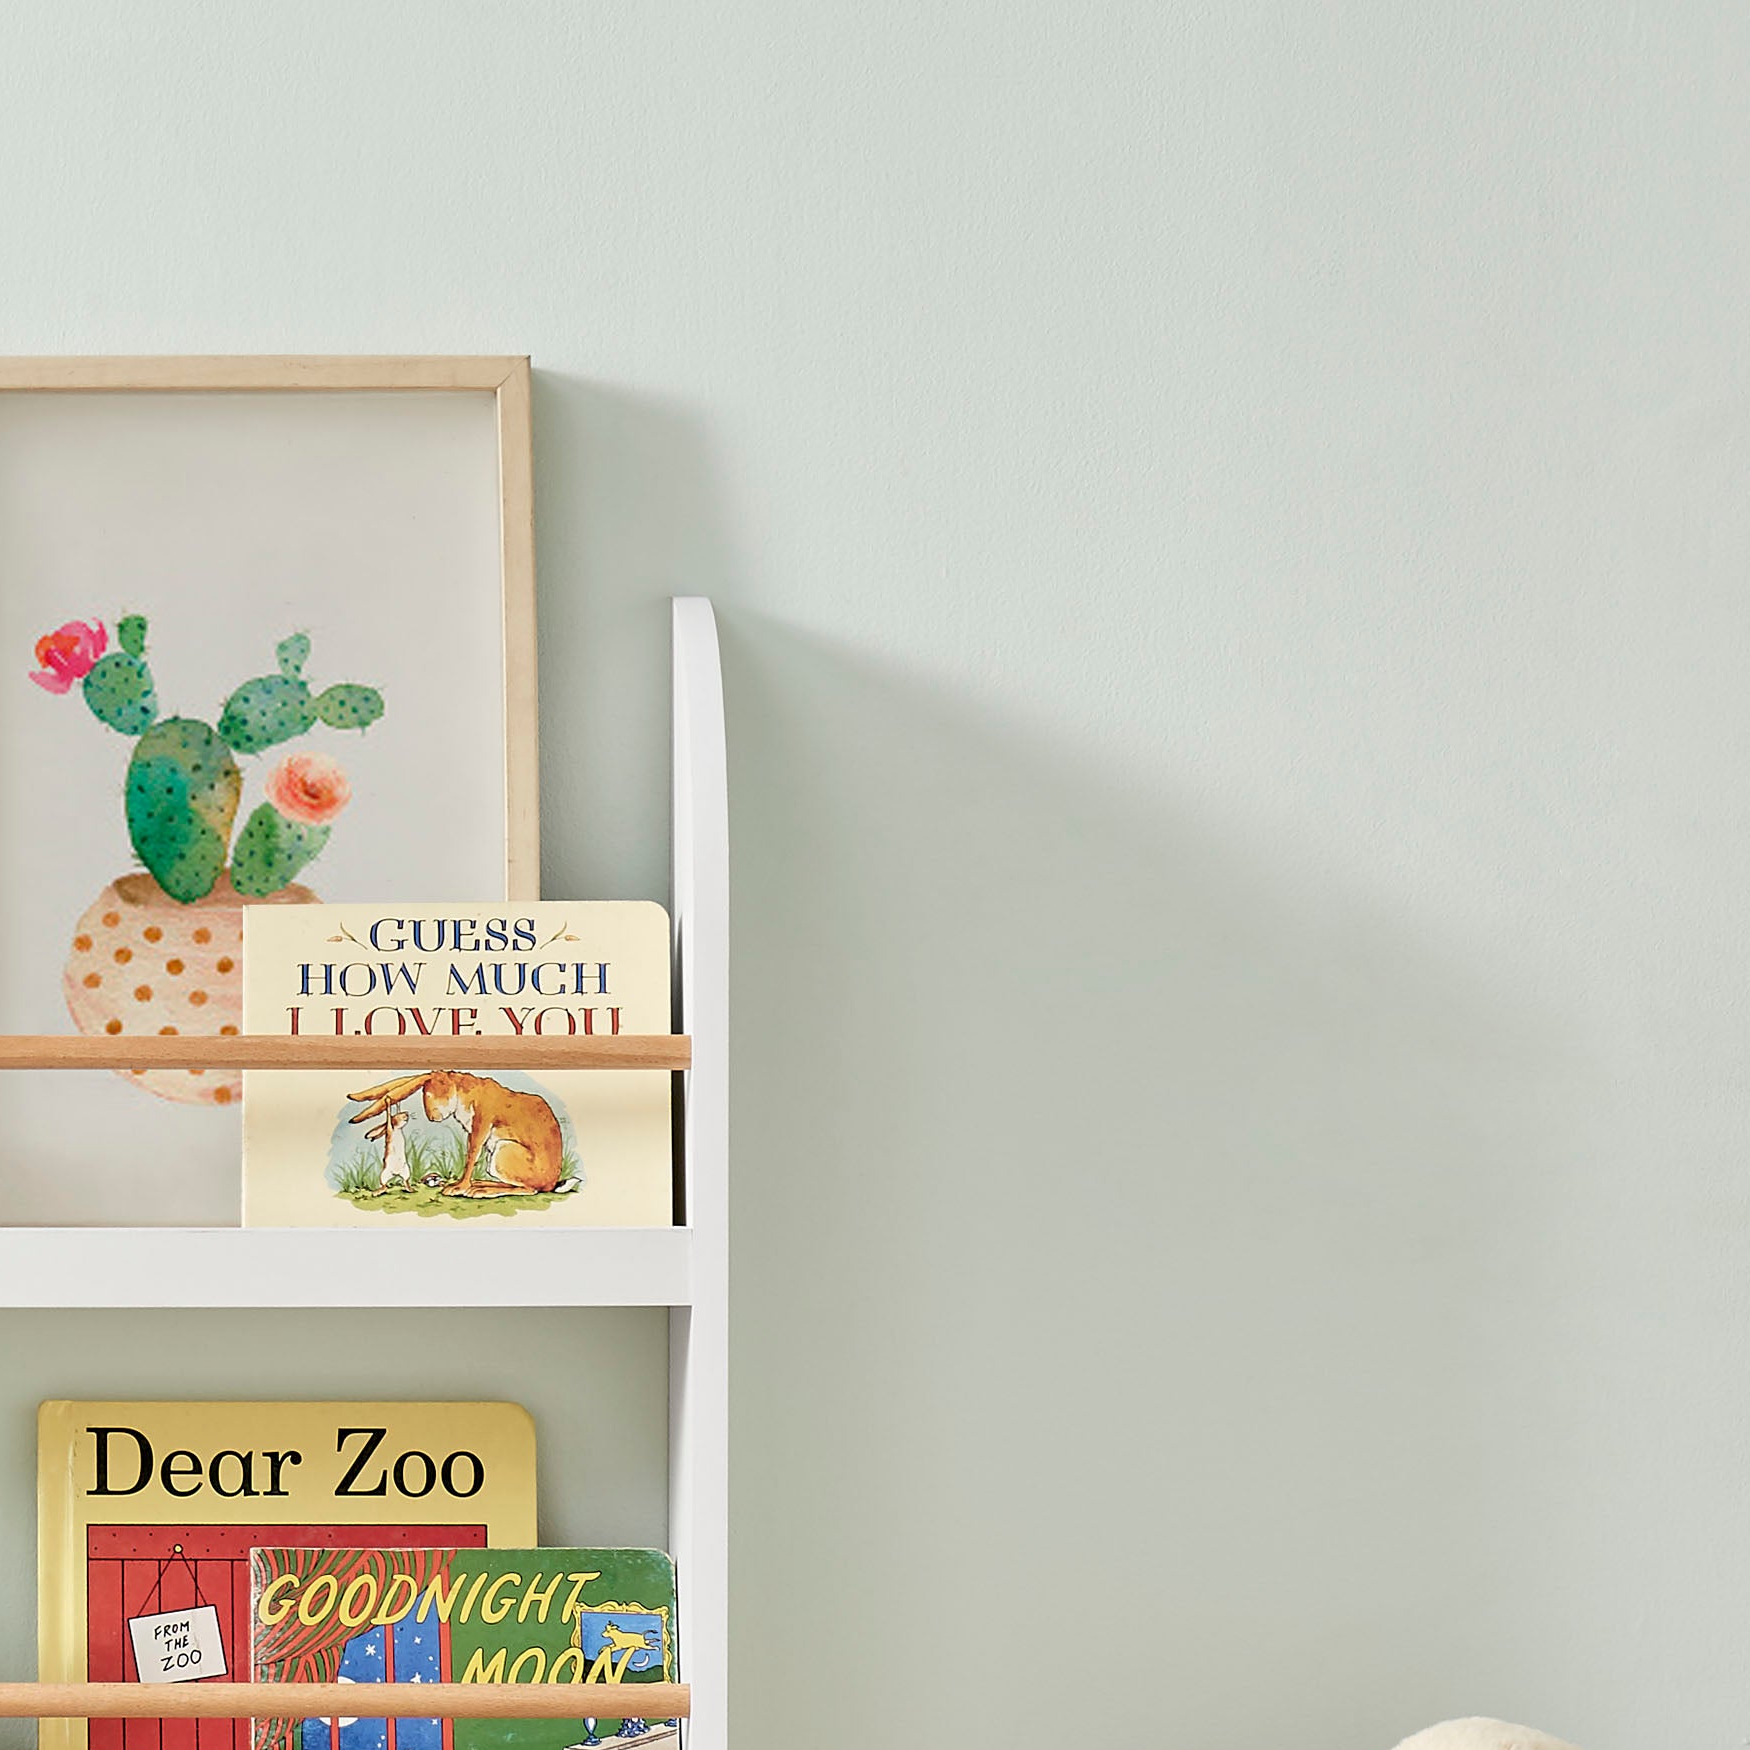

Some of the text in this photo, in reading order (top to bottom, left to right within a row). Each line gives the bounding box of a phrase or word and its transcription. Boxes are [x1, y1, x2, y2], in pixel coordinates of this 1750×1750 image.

[370, 917, 537, 953] GUESS
[295, 962, 612, 997] HOW MUCH
[286, 1006, 624, 1035] I LOVE YOU
[85, 1426, 486, 1498] Dear Zoo
[258, 1571, 602, 1626] GOODNIGHT
[153, 1620, 190, 1641] FROM
[164, 1634, 190, 1652] THE
[160, 1649, 203, 1672] ZOO
[459, 1646, 637, 1684] MOON
